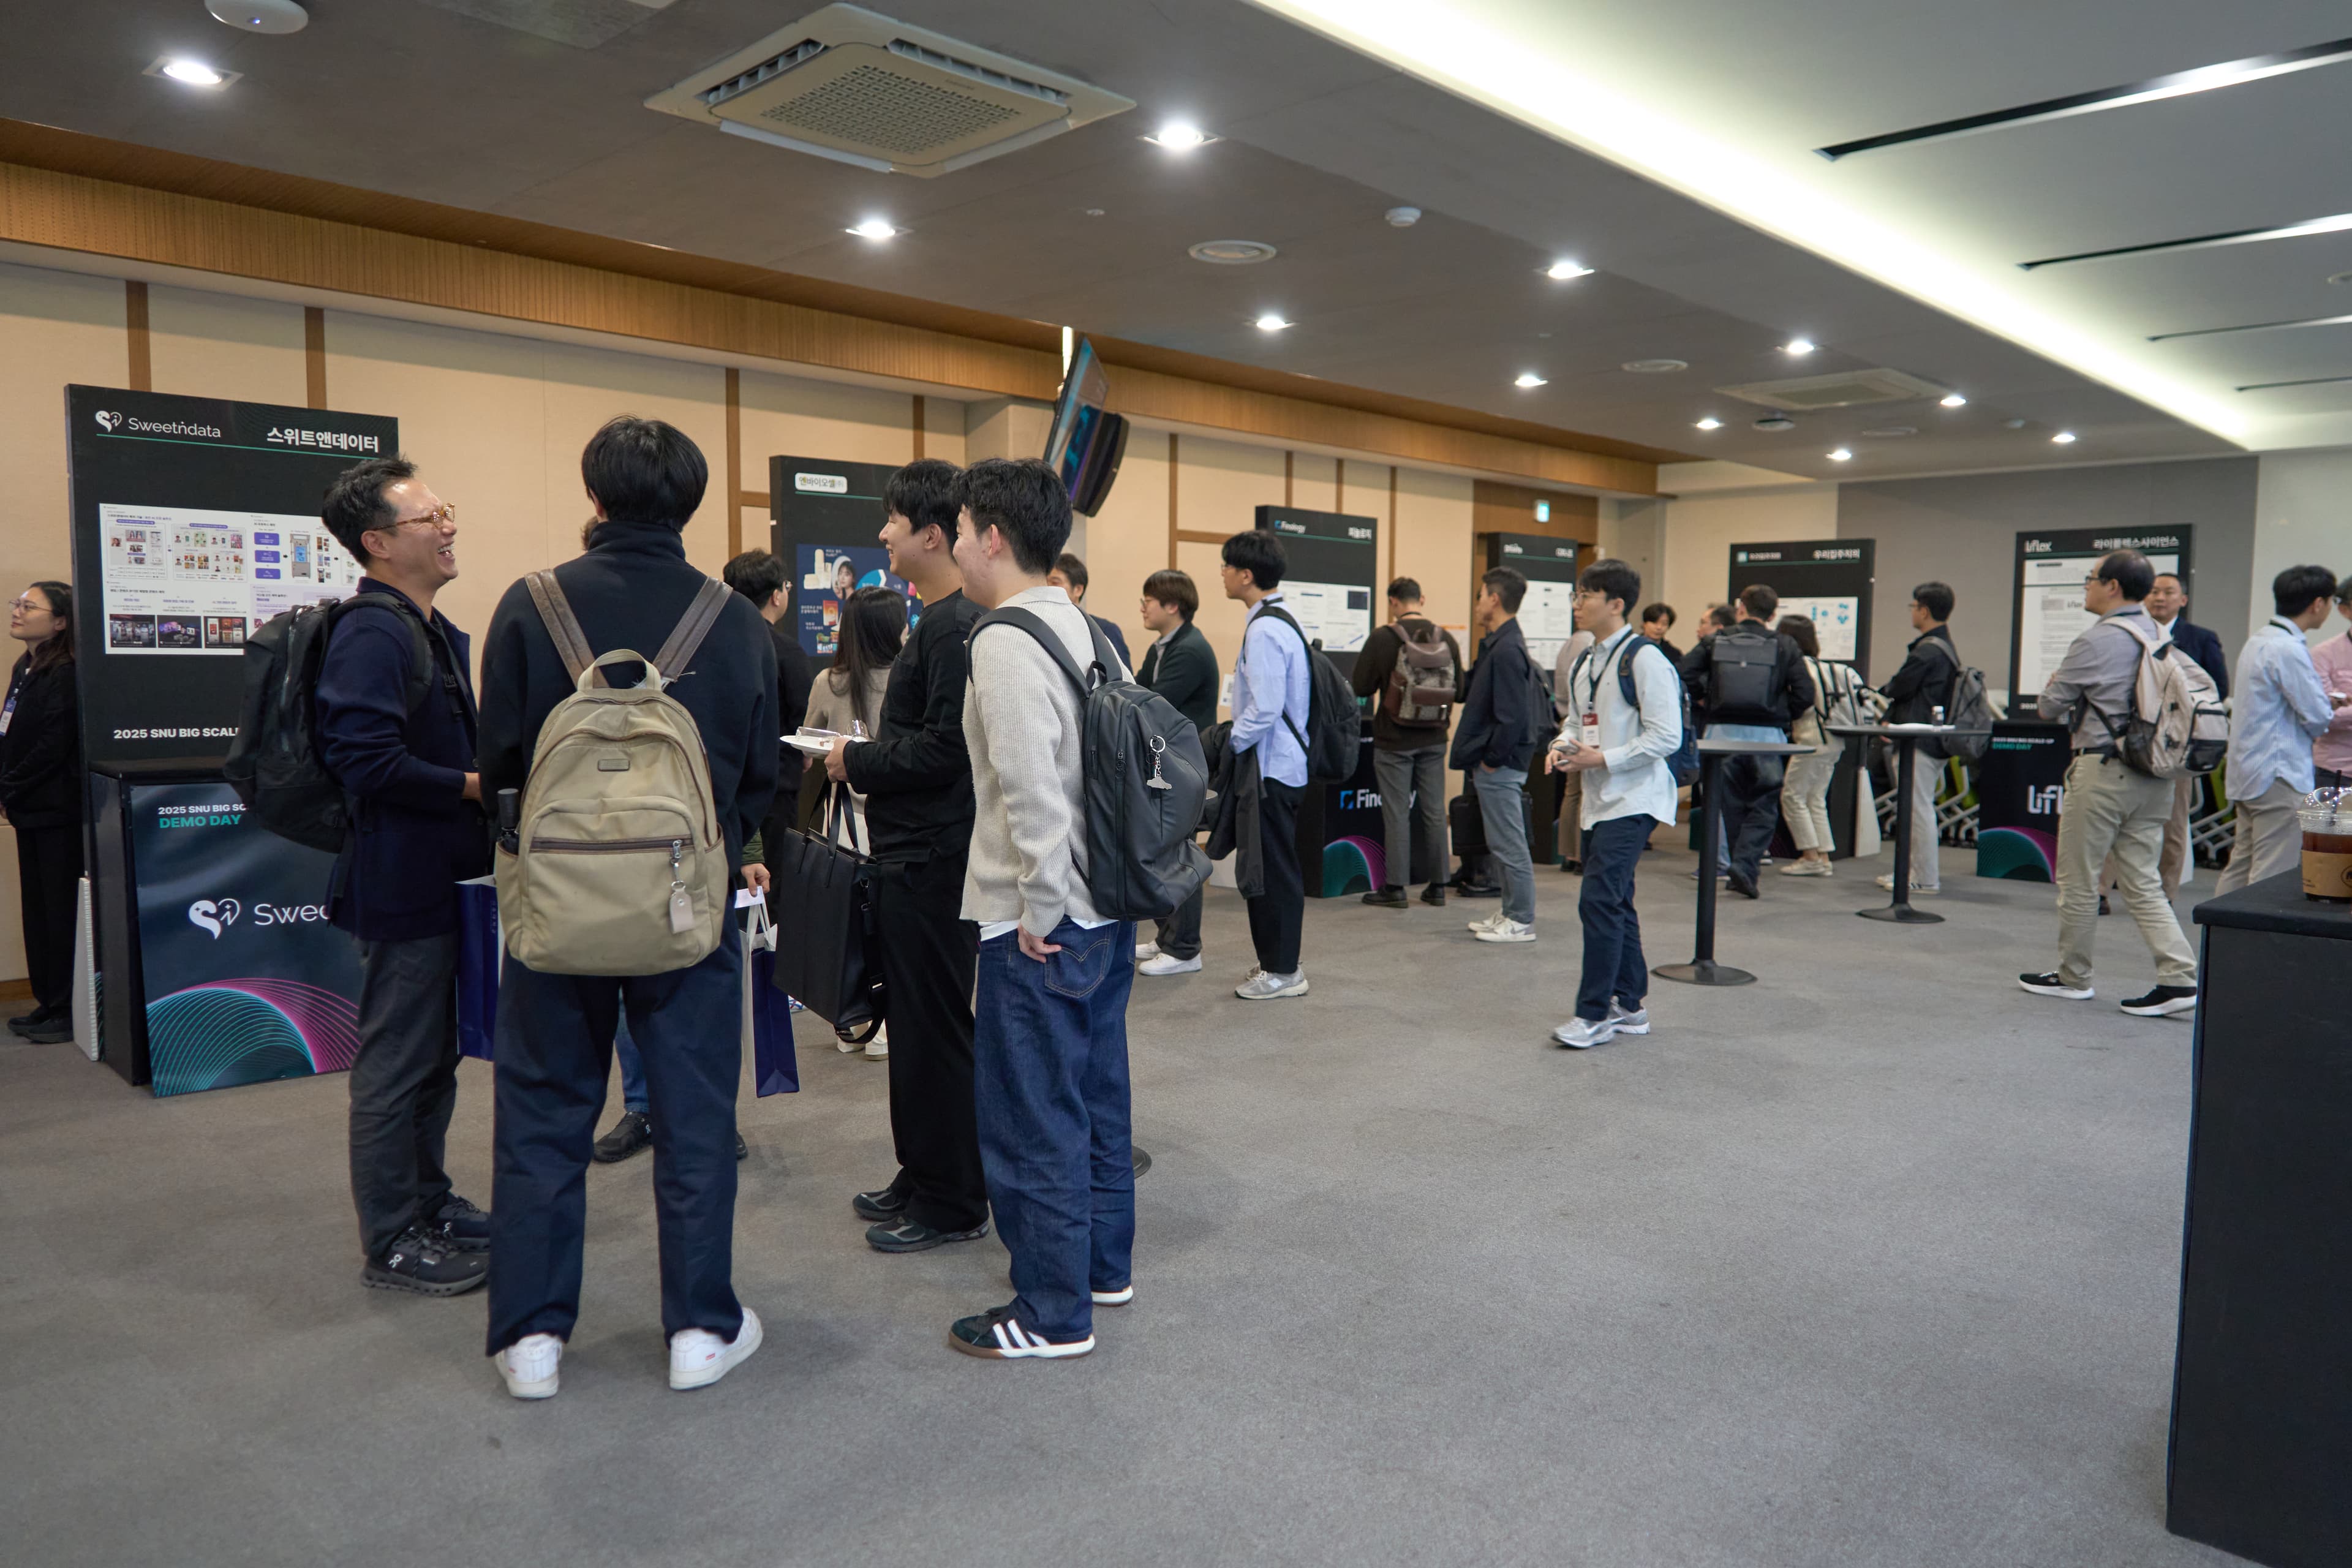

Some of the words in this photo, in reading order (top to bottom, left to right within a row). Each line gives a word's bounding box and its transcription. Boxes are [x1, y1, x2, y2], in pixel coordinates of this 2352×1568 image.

[266, 427, 379, 453] 스위트앤데이터
[113, 729, 148, 739] 2025
[150, 728, 176, 738] SNU
[178, 728, 200, 737] BIG
[158, 805, 187, 815] 2025
[188, 805, 210, 813] SNU
[159, 816, 206, 829] DEMO
[209, 814, 241, 826] DAY
